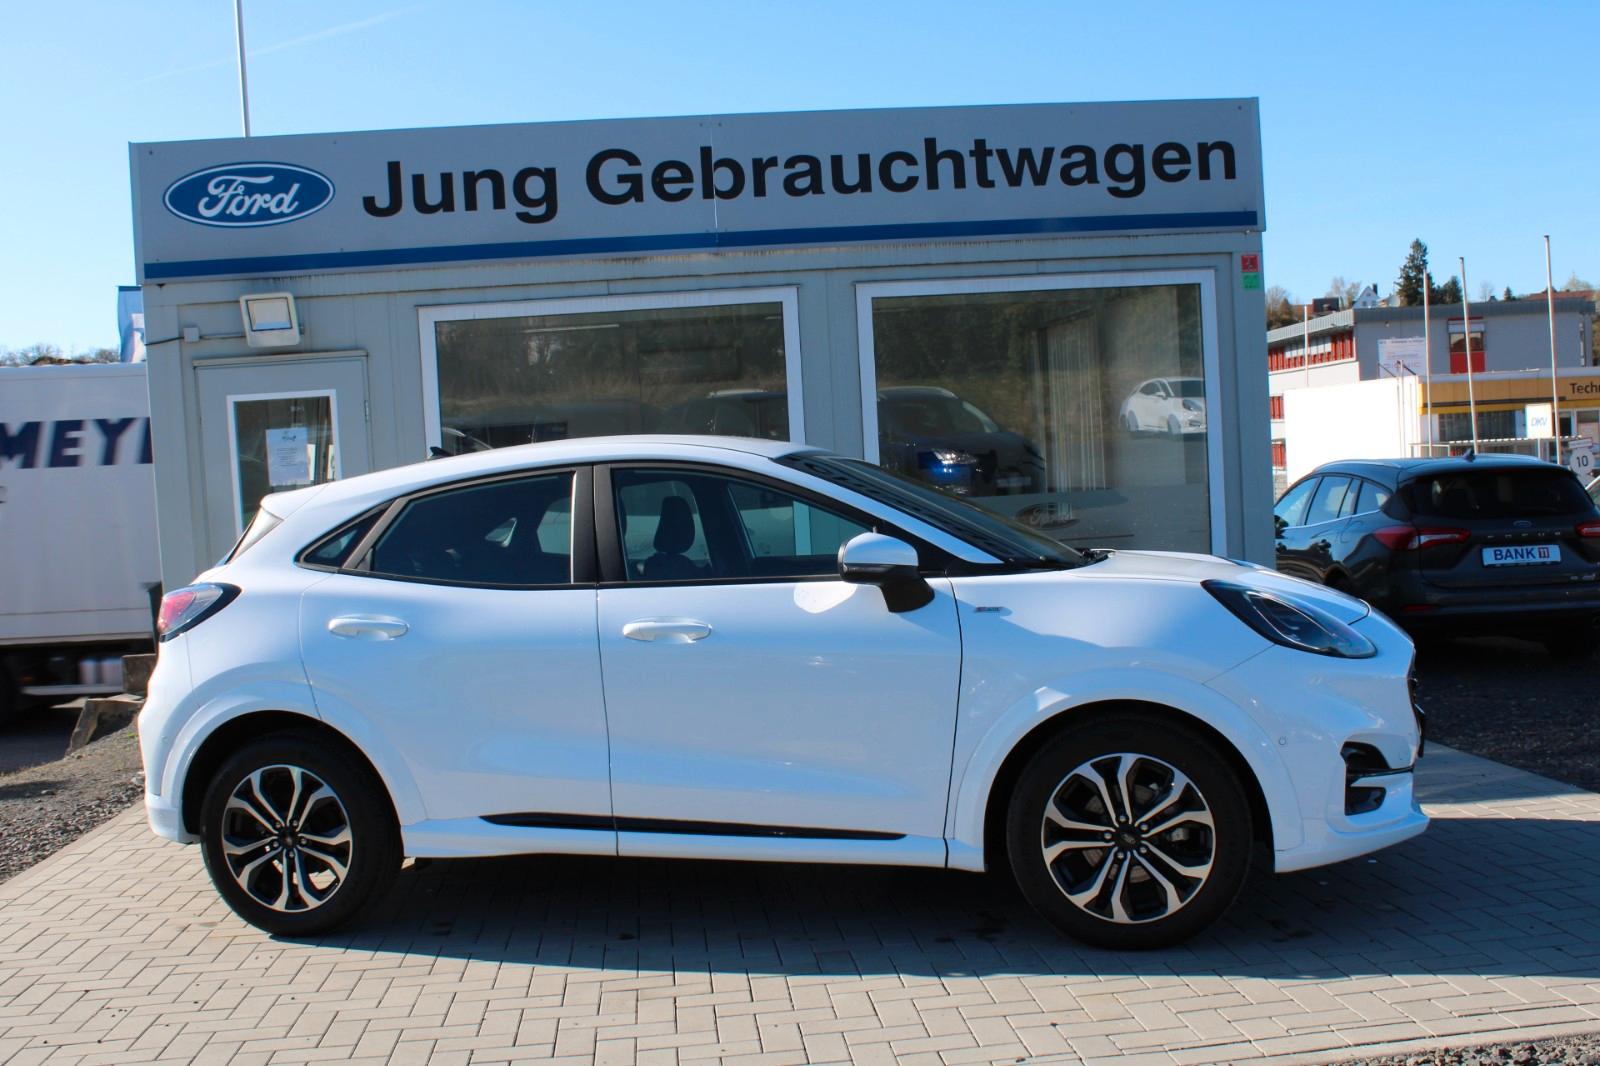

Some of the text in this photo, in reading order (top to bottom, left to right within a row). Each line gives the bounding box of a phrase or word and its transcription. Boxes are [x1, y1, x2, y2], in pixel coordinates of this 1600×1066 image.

[362, 137, 1237, 225] Jung Gebrauchtwagen
[197, 175, 300, 218] Ford
[1576, 455, 1589, 468] 10
[1493, 547, 1536, 561] BANK
